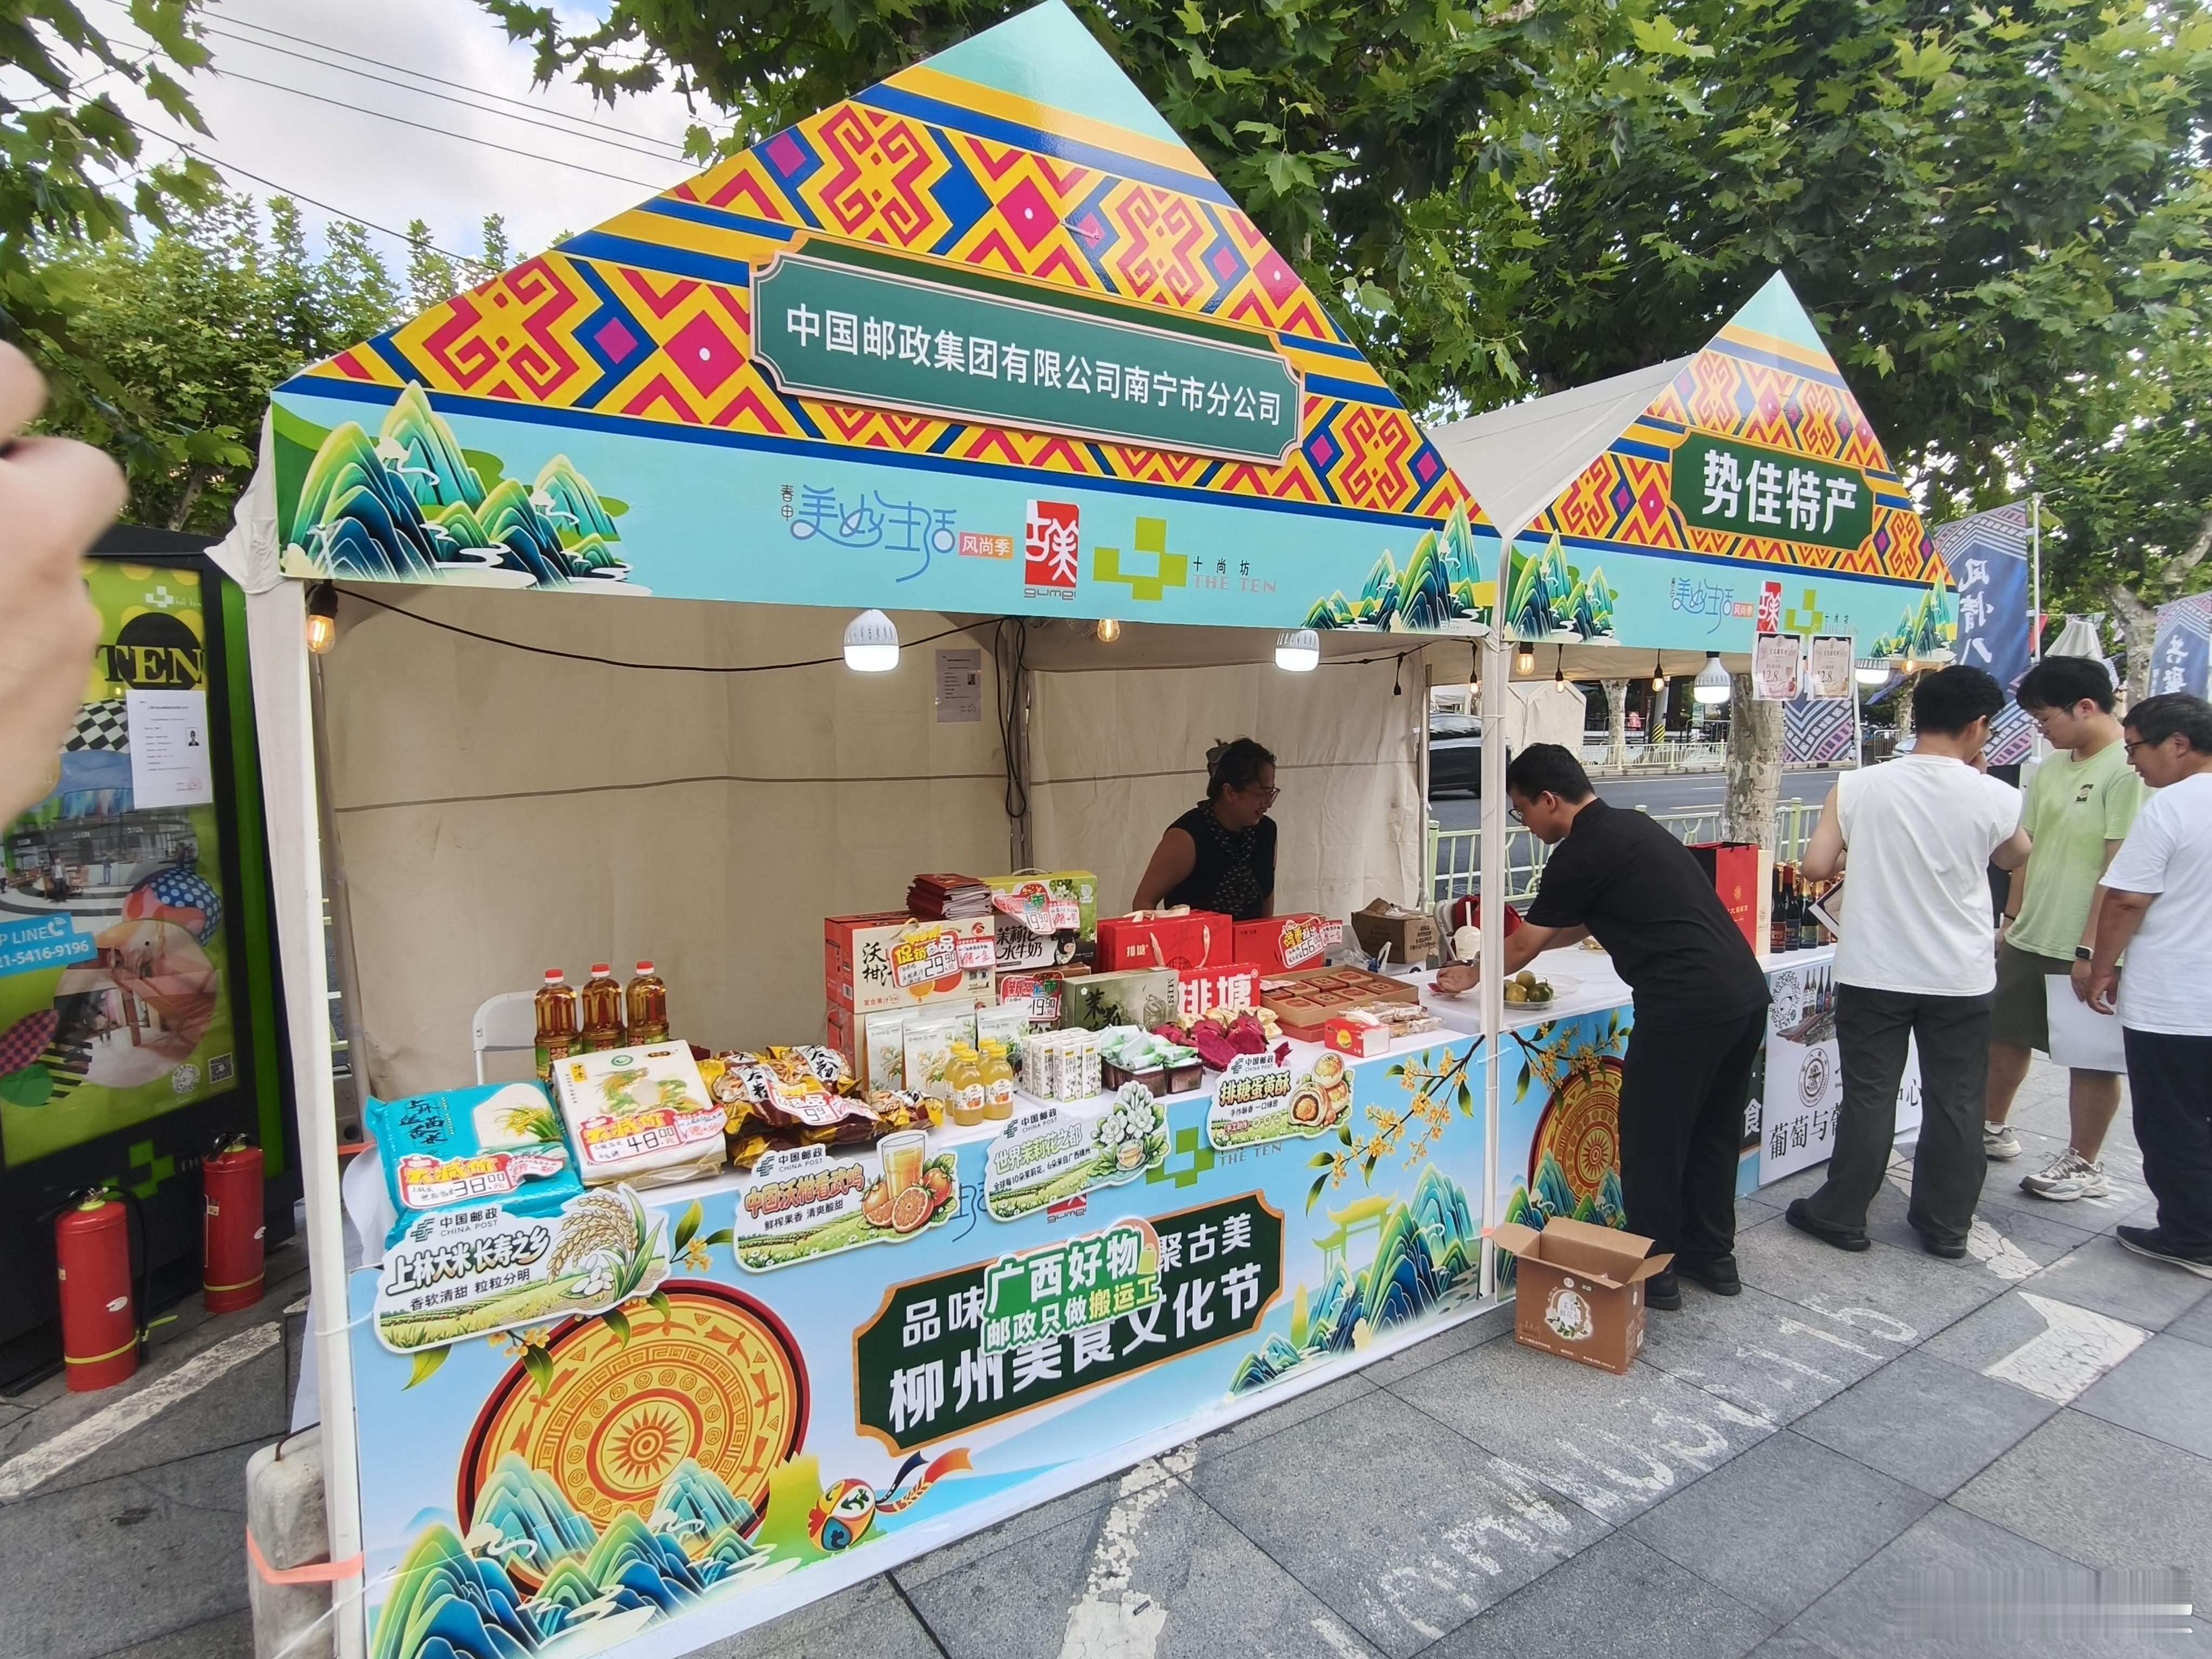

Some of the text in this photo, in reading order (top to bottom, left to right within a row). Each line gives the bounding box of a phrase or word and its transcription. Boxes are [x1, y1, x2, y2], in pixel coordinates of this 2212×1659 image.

[786, 303, 1280, 426] 中国邮政集团有限公司南宁市分公司
[1703, 449, 1856, 534] 势佳特产
[961, 536, 1010, 554] 风尚季
[1193, 556, 1250, 576] 十尚坊
[1193, 574, 1277, 593] THE TEN
[1024, 588, 1076, 601] gumei
[12, 927, 48, 944] LINE
[996, 942, 1043, 960] 水牛奶
[1245, 1055, 1273, 1066] 中国邮政
[585, 1111, 666, 1144] 大减价
[1021, 1108, 1057, 1127] 中国邮政
[1022, 1116, 1057, 1133] CHINA POST
[778, 1147, 822, 1165] 中国邮政
[994, 1123, 1082, 1175] 世界茉莉花之都
[1219, 1143, 1282, 1166] THE TEN
[406, 1157, 500, 1185] 大减价
[779, 1158, 822, 1172] CHINA POST
[744, 1163, 865, 1219] 中国沃柑看武鸣
[440, 1208, 497, 1228] 中国邮政
[764, 1198, 843, 1231] 鲜榨果香 清爽酸甜
[1047, 1207, 1087, 1224] gumei
[440, 1219, 498, 1237] CHINA POST
[385, 1225, 551, 1297] 上林大米 长寿之乡
[987, 1229, 1140, 1315] 广西好物
[410, 1268, 530, 1312] 香软清甜 粒粒分明
[986, 1276, 1159, 1346] 邮政只做搬运工
